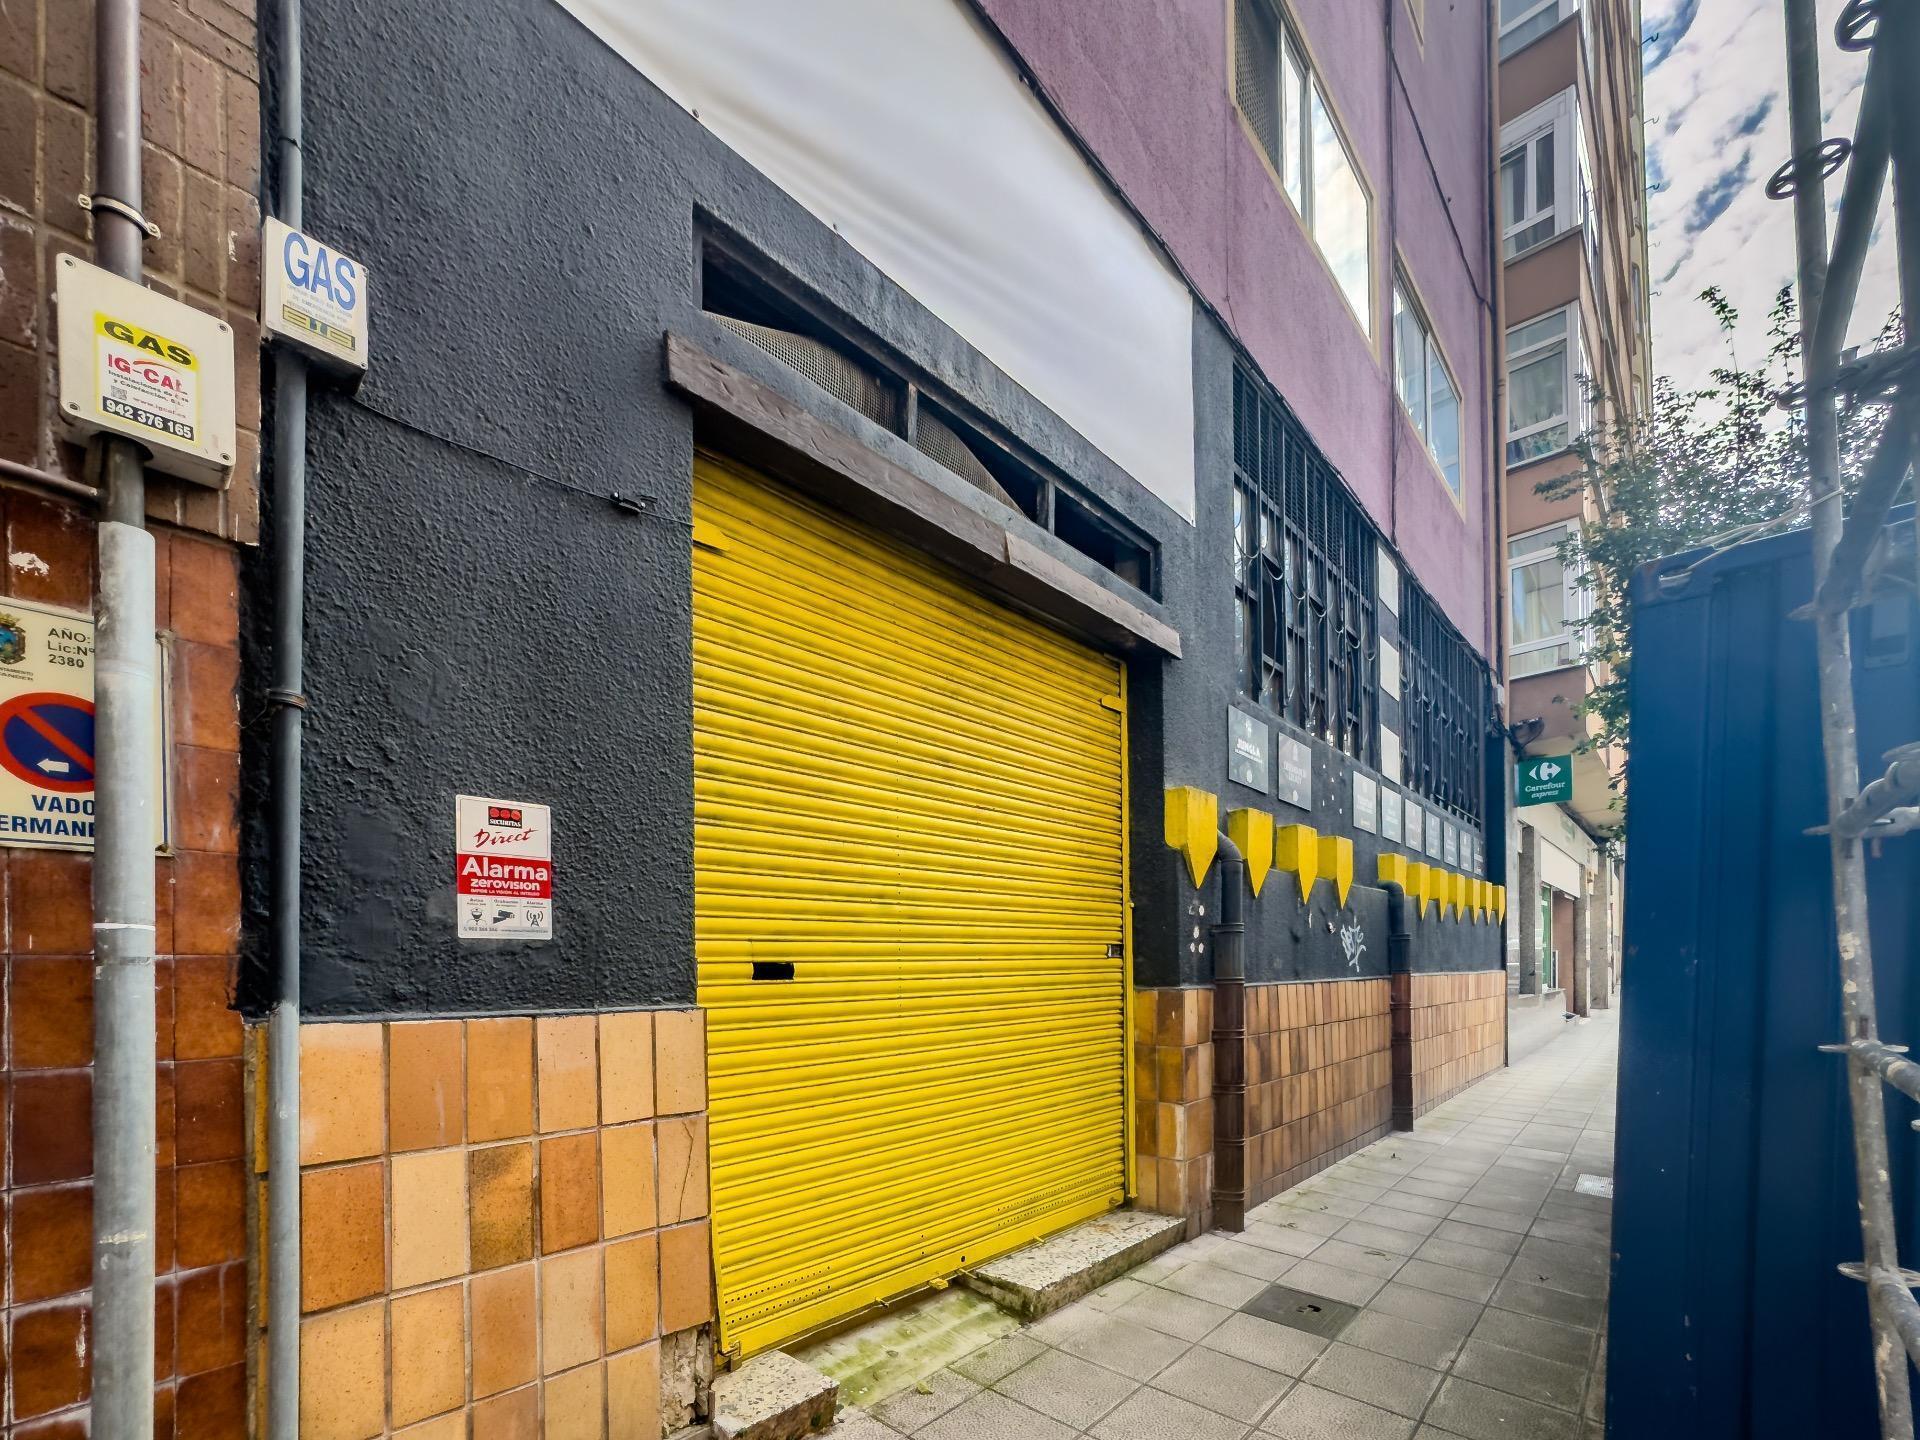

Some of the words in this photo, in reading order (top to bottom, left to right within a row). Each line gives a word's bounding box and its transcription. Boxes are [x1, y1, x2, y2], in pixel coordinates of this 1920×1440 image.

[284, 232, 355, 311] GAS
[104, 321, 191, 365] GAS
[106, 401, 134, 420] 942
[138, 411, 164, 428] 376
[168, 421, 191, 438] 165
[48, 628, 90, 644] AÑO:
[49, 653, 84, 668] 2380
[1525, 782, 1565, 792] Carrefour
[1531, 790, 1559, 799] express
[32, 795, 95, 815] VADO
[490, 818, 521, 828] SECURITAS
[474, 828, 538, 848] Direct
[461, 857, 548, 881] Alarma
[470, 878, 540, 891] zerovision
